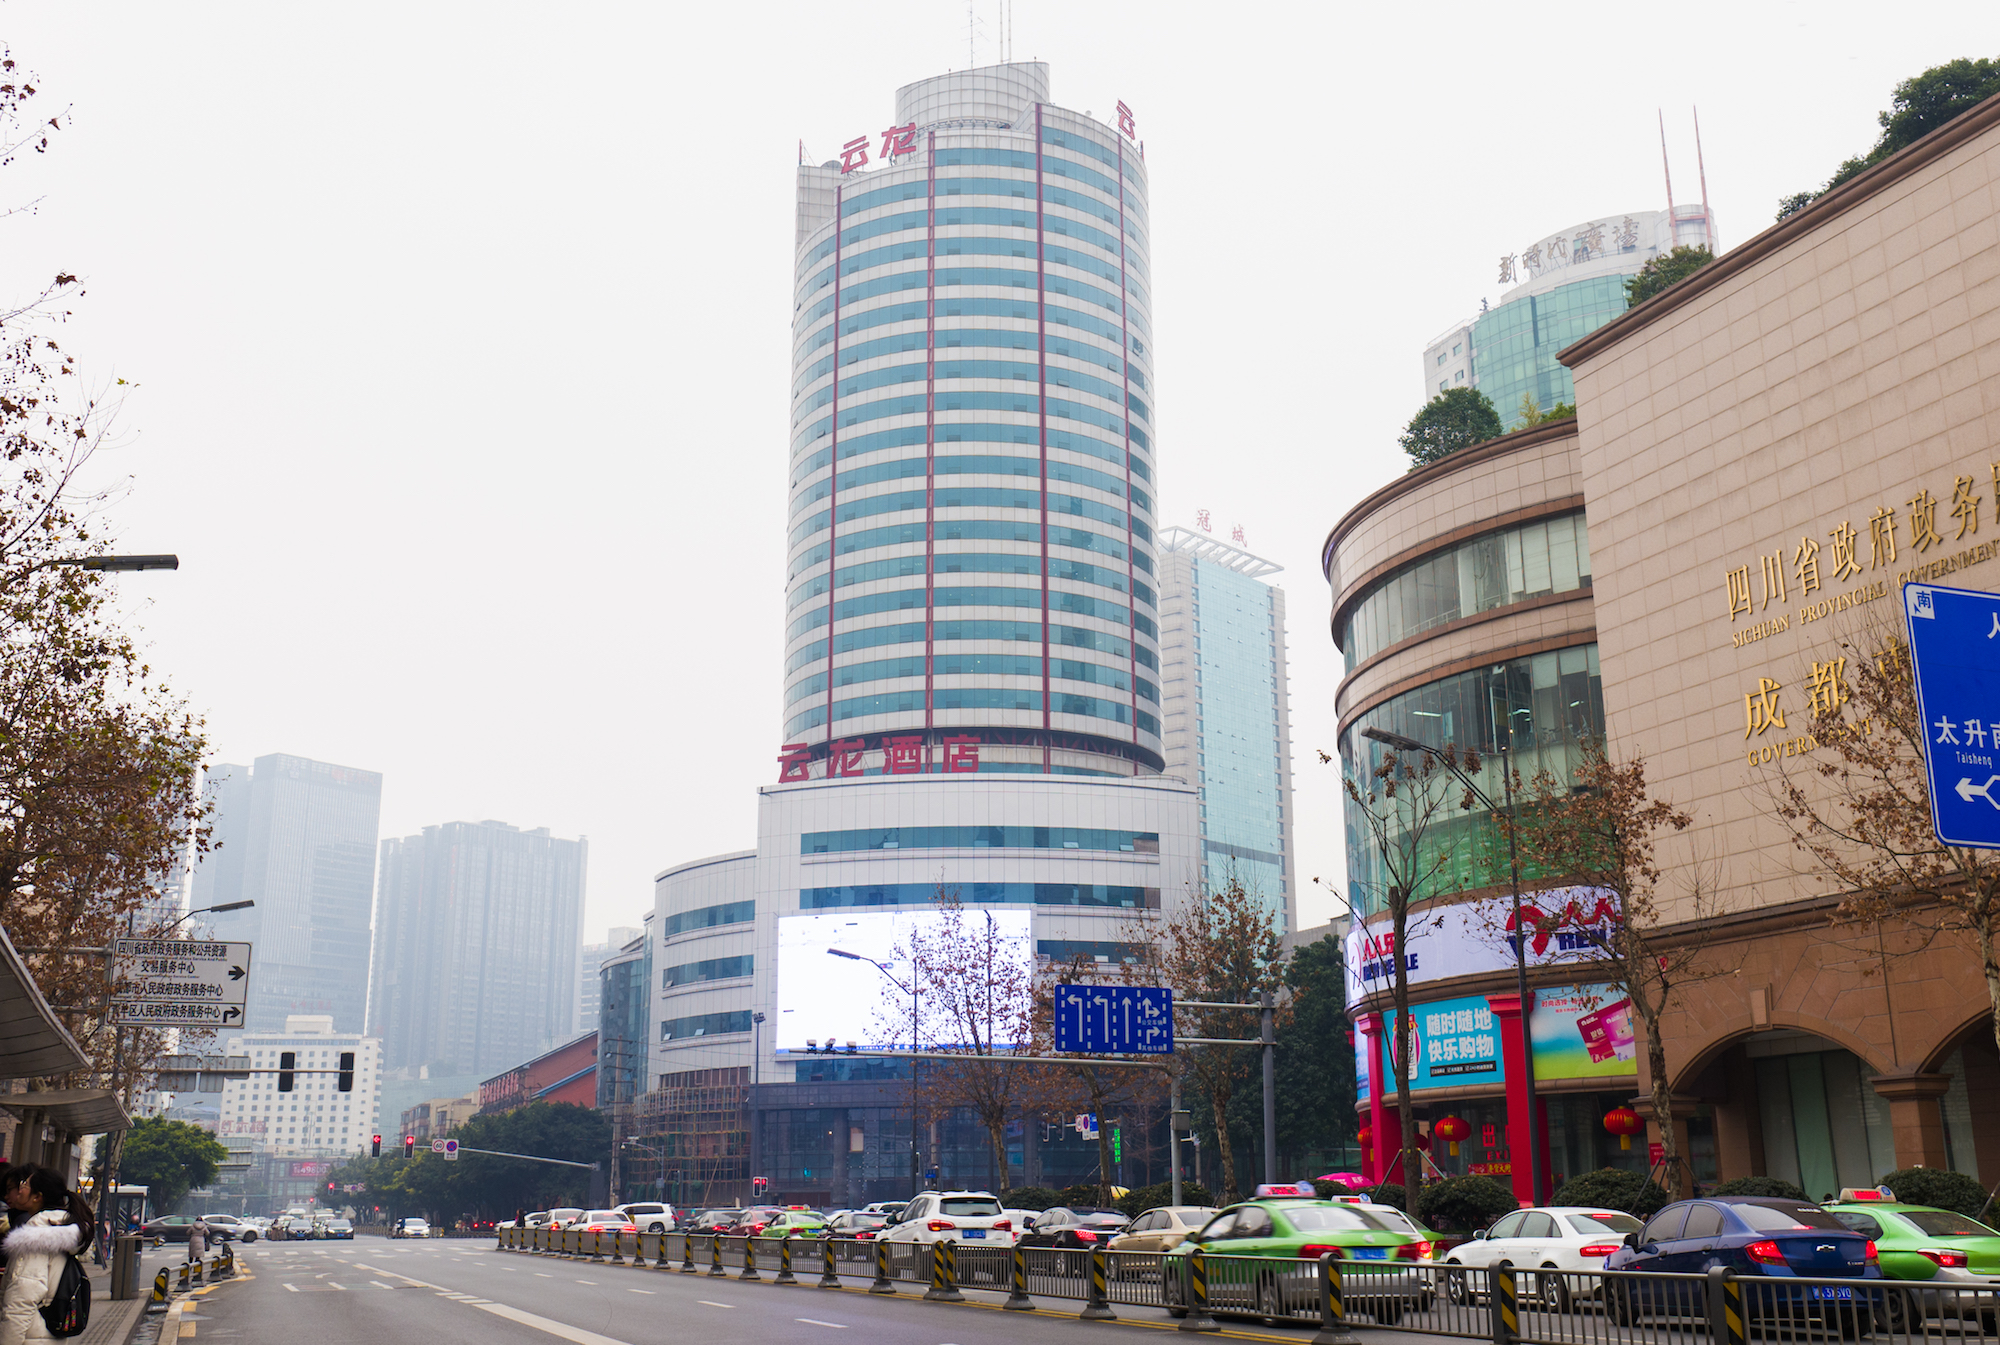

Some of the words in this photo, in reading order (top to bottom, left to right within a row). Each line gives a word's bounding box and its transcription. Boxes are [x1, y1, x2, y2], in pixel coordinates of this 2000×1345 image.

[840, 122, 918, 175] 云龙
[1197, 509, 1248, 548] 冠城
[1916, 590, 1931, 609] 南
[1732, 614, 1791, 649] SICHUAN
[1799, 580, 1888, 626] PROVINCIAL
[1747, 717, 1872, 767] GOVERNNT
[777, 734, 981, 783] 云龙酒店
[1955, 751, 1993, 769] Taisheng
[1559, 929, 1607, 951] REN
[141, 960, 196, 974] 交易服务中心
[1426, 1007, 1493, 1037] 随时随地
[1427, 1034, 1494, 1063] 快乐购物
[1487, 1150, 1508, 1161] EXI
